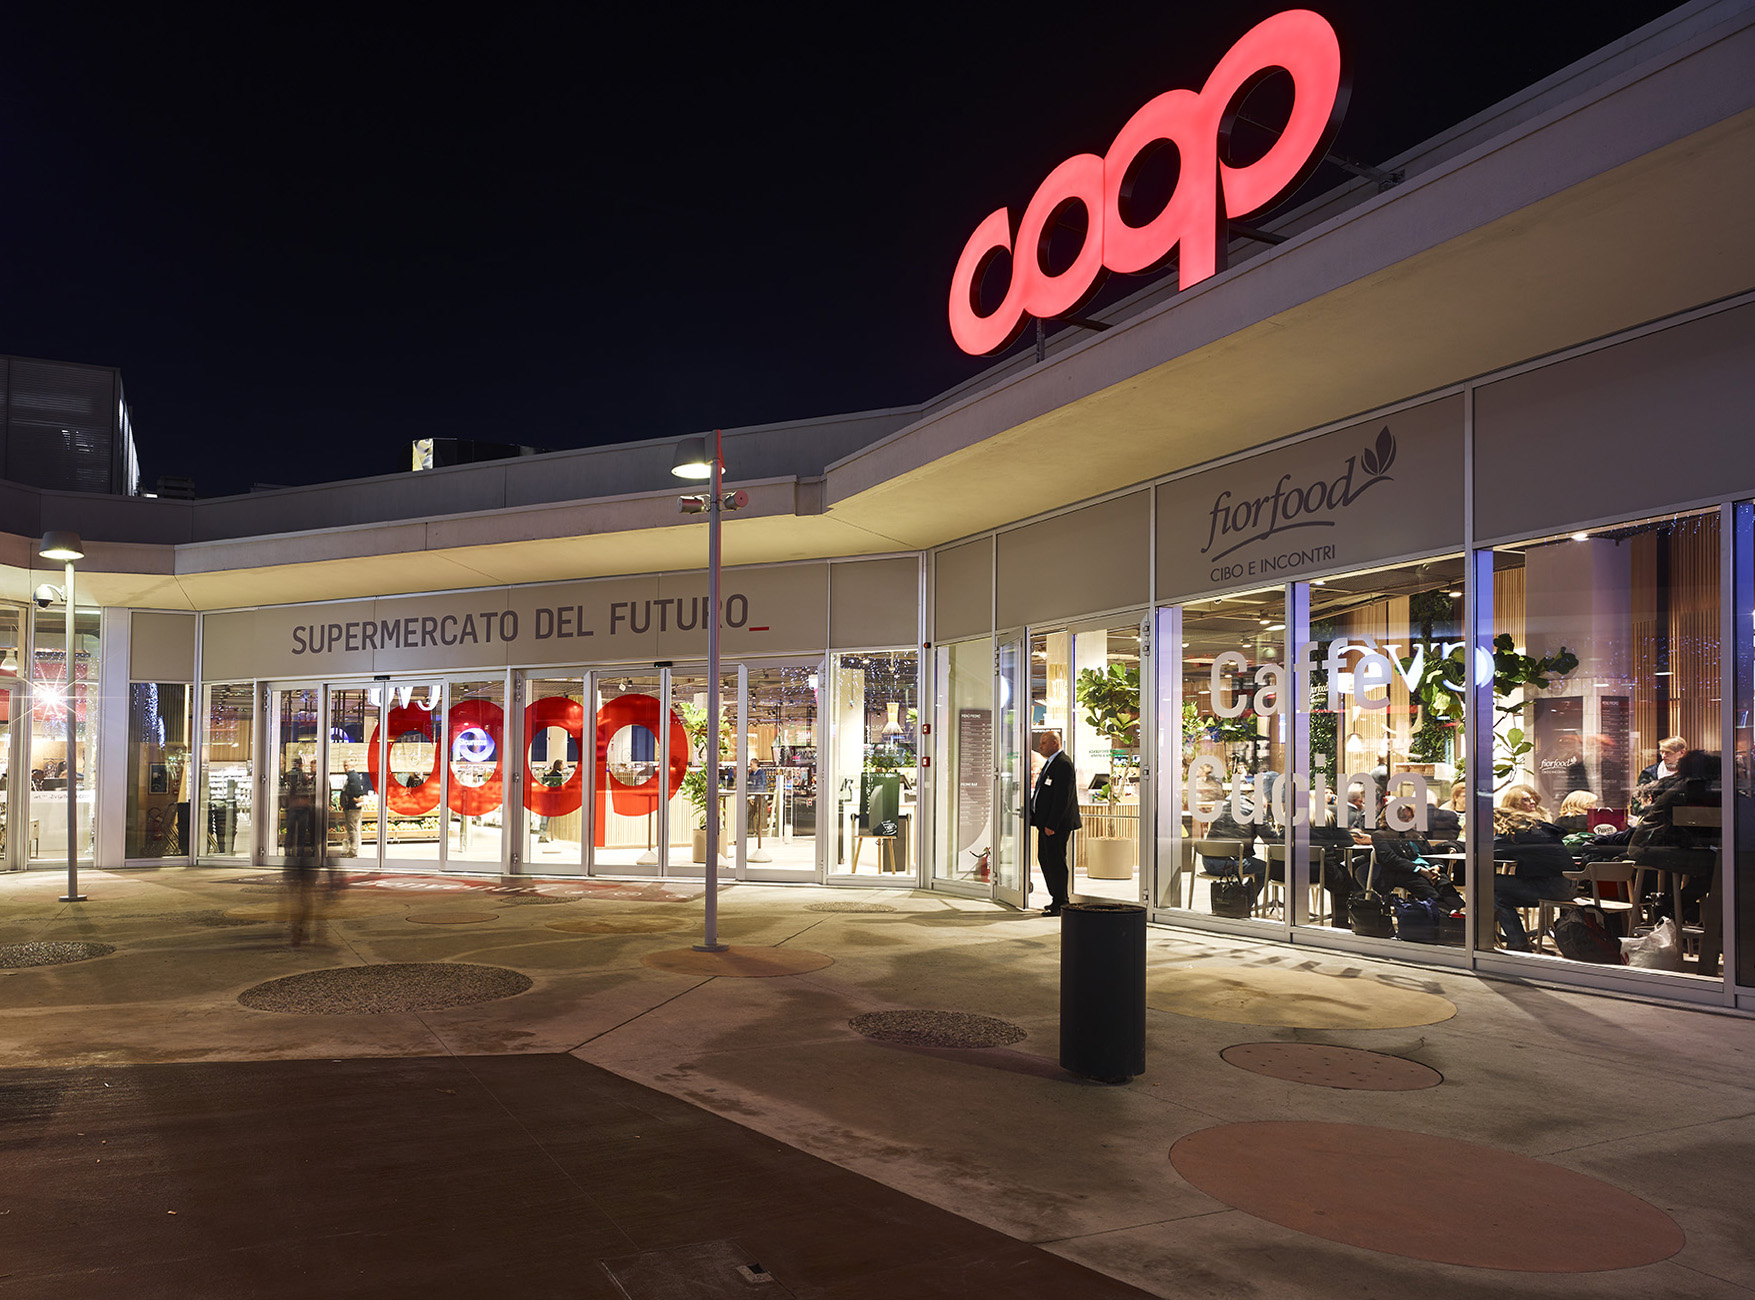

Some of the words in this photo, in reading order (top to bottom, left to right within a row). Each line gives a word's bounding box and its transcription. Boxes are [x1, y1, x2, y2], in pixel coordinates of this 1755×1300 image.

[949, 9, 1341, 355] coop
[1201, 455, 1384, 554] fiorfood
[1210, 562, 1243, 582] CIBO
[1248, 559, 1255, 574] E
[1260, 544, 1336, 571] INCONTRI
[291, 609, 519, 655] SUPERMERCATO
[535, 605, 594, 640] DEL
[1210, 634, 1391, 719] Caffè
[368, 694, 689, 847] coop
[1188, 753, 1428, 832] Cucina
